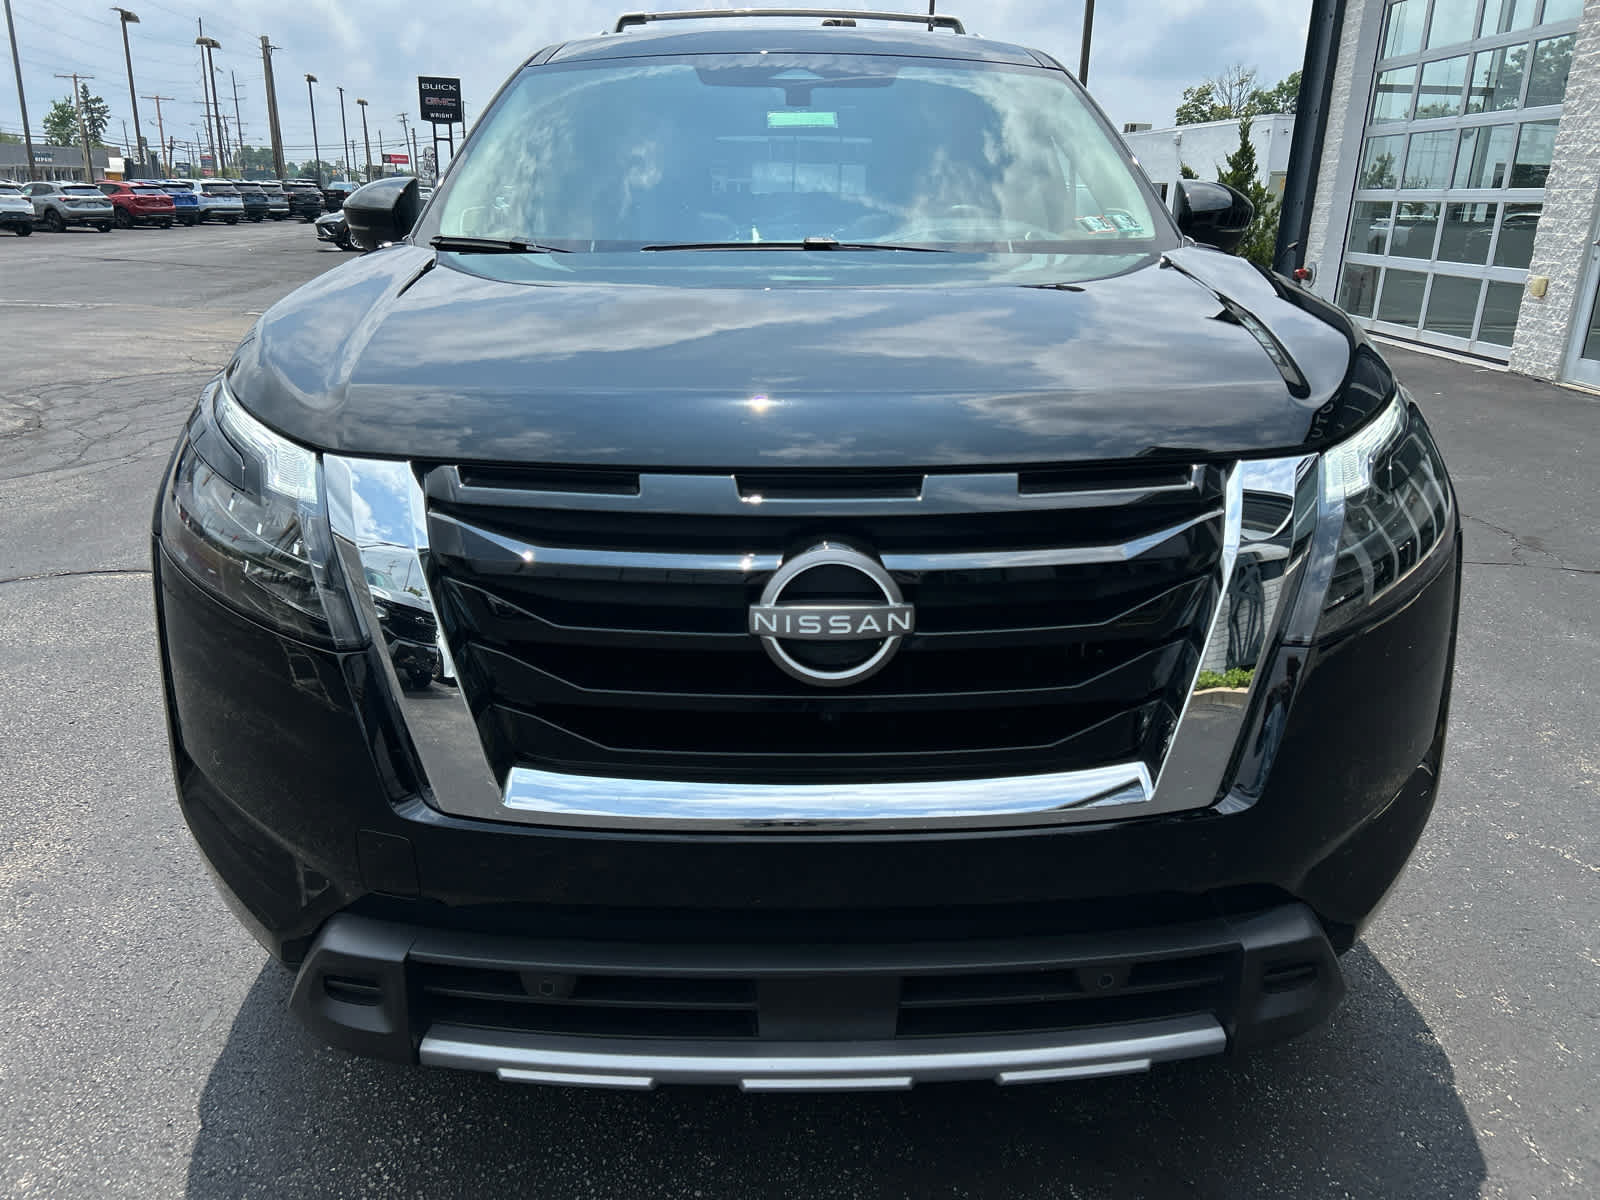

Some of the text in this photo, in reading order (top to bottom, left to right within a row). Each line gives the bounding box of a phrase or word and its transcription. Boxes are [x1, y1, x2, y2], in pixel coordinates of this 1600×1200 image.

[421, 83, 457, 91] BUICK
[424, 97, 456, 107] GMC
[754, 611, 911, 635] NISSAN
